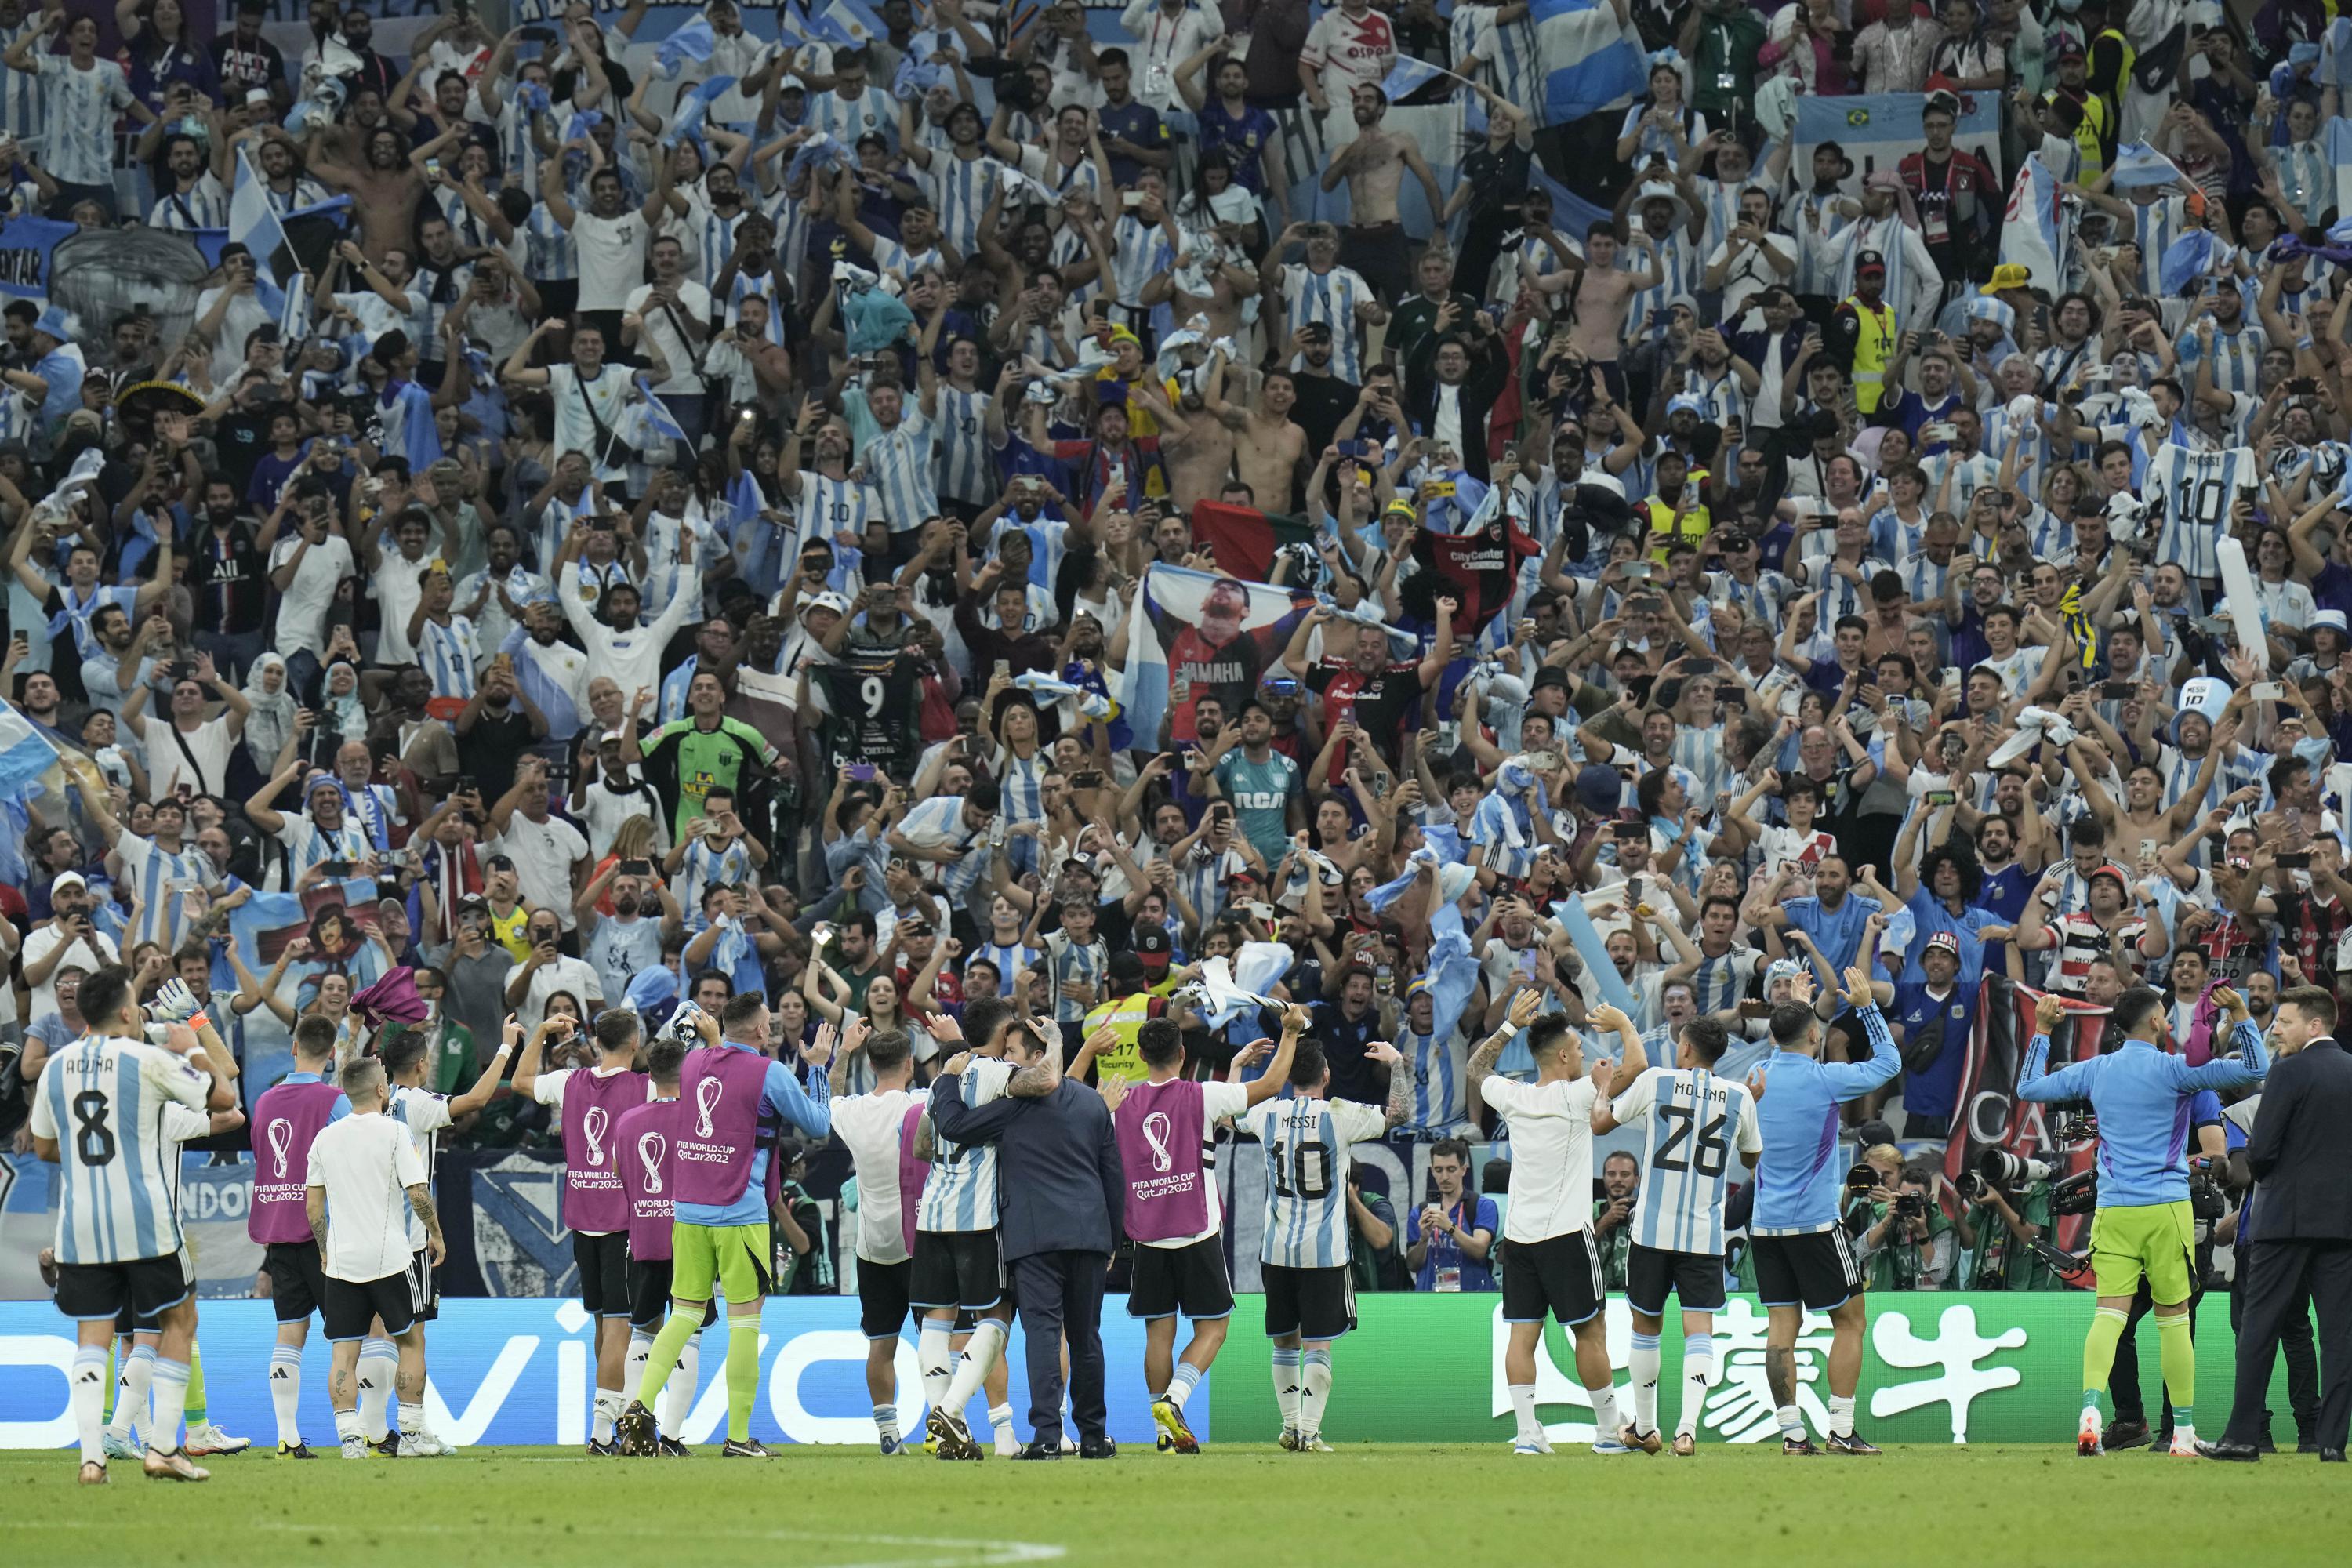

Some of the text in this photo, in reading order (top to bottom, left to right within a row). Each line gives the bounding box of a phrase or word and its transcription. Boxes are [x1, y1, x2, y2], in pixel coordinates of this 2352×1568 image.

[223, 49, 270, 70] PARTY
[220, 62, 269, 84] HARD
[2188, 454, 2220, 467] MESSI
[2177, 477, 2226, 526] 10
[829, 503, 849, 522] 10
[1838, 599, 1855, 615] 10
[1181, 662, 1244, 682] YAMAHA
[861, 676, 885, 718] 9
[2185, 695, 2204, 706] 10
[695, 771, 715, 784] LA
[1233, 792, 1285, 809] RCA
[1101, 1059, 1135, 1070] Security
[1675, 1083, 1726, 1103] MOLINA
[73, 1091, 116, 1167] 8
[1282, 1116, 1316, 1128] MESSI
[677, 1140, 735, 1154] FIFA WORLD CUP
[1653, 1105, 1728, 1178] 26
[1270, 1141, 1331, 1200] 10
[292, 1182, 308, 1192] CUP
[1132, 1172, 1196, 1190] FIFA WORLD CUP
[637, 1199, 670, 1208] WORLD
[1704, 1297, 2027, 1444] 蒙牛
